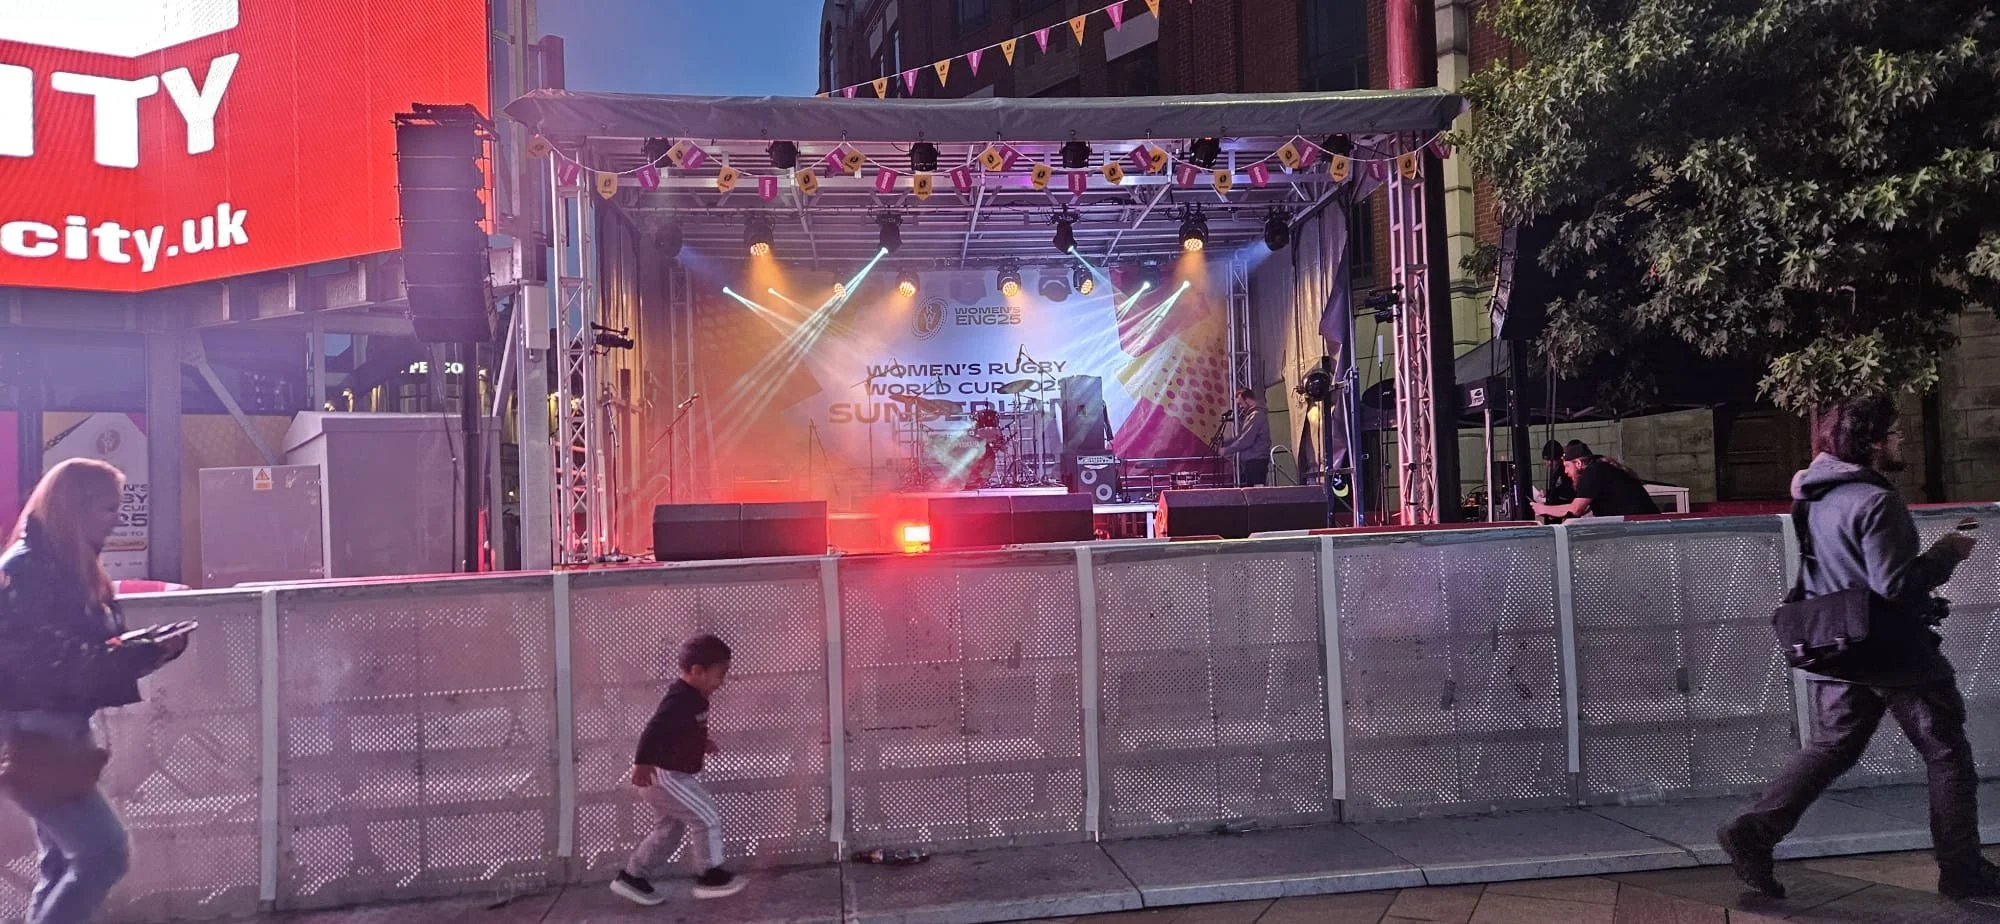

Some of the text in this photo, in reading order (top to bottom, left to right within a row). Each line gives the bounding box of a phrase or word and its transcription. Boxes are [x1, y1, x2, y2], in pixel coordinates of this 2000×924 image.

[0, 202, 249, 273] city.uk
[955, 306, 1021, 315] WOMEN'S
[955, 314, 1022, 326] ENG25
[866, 360, 1067, 378] WOMEN'S RUGBY
[866, 381, 951, 396] WORLD
